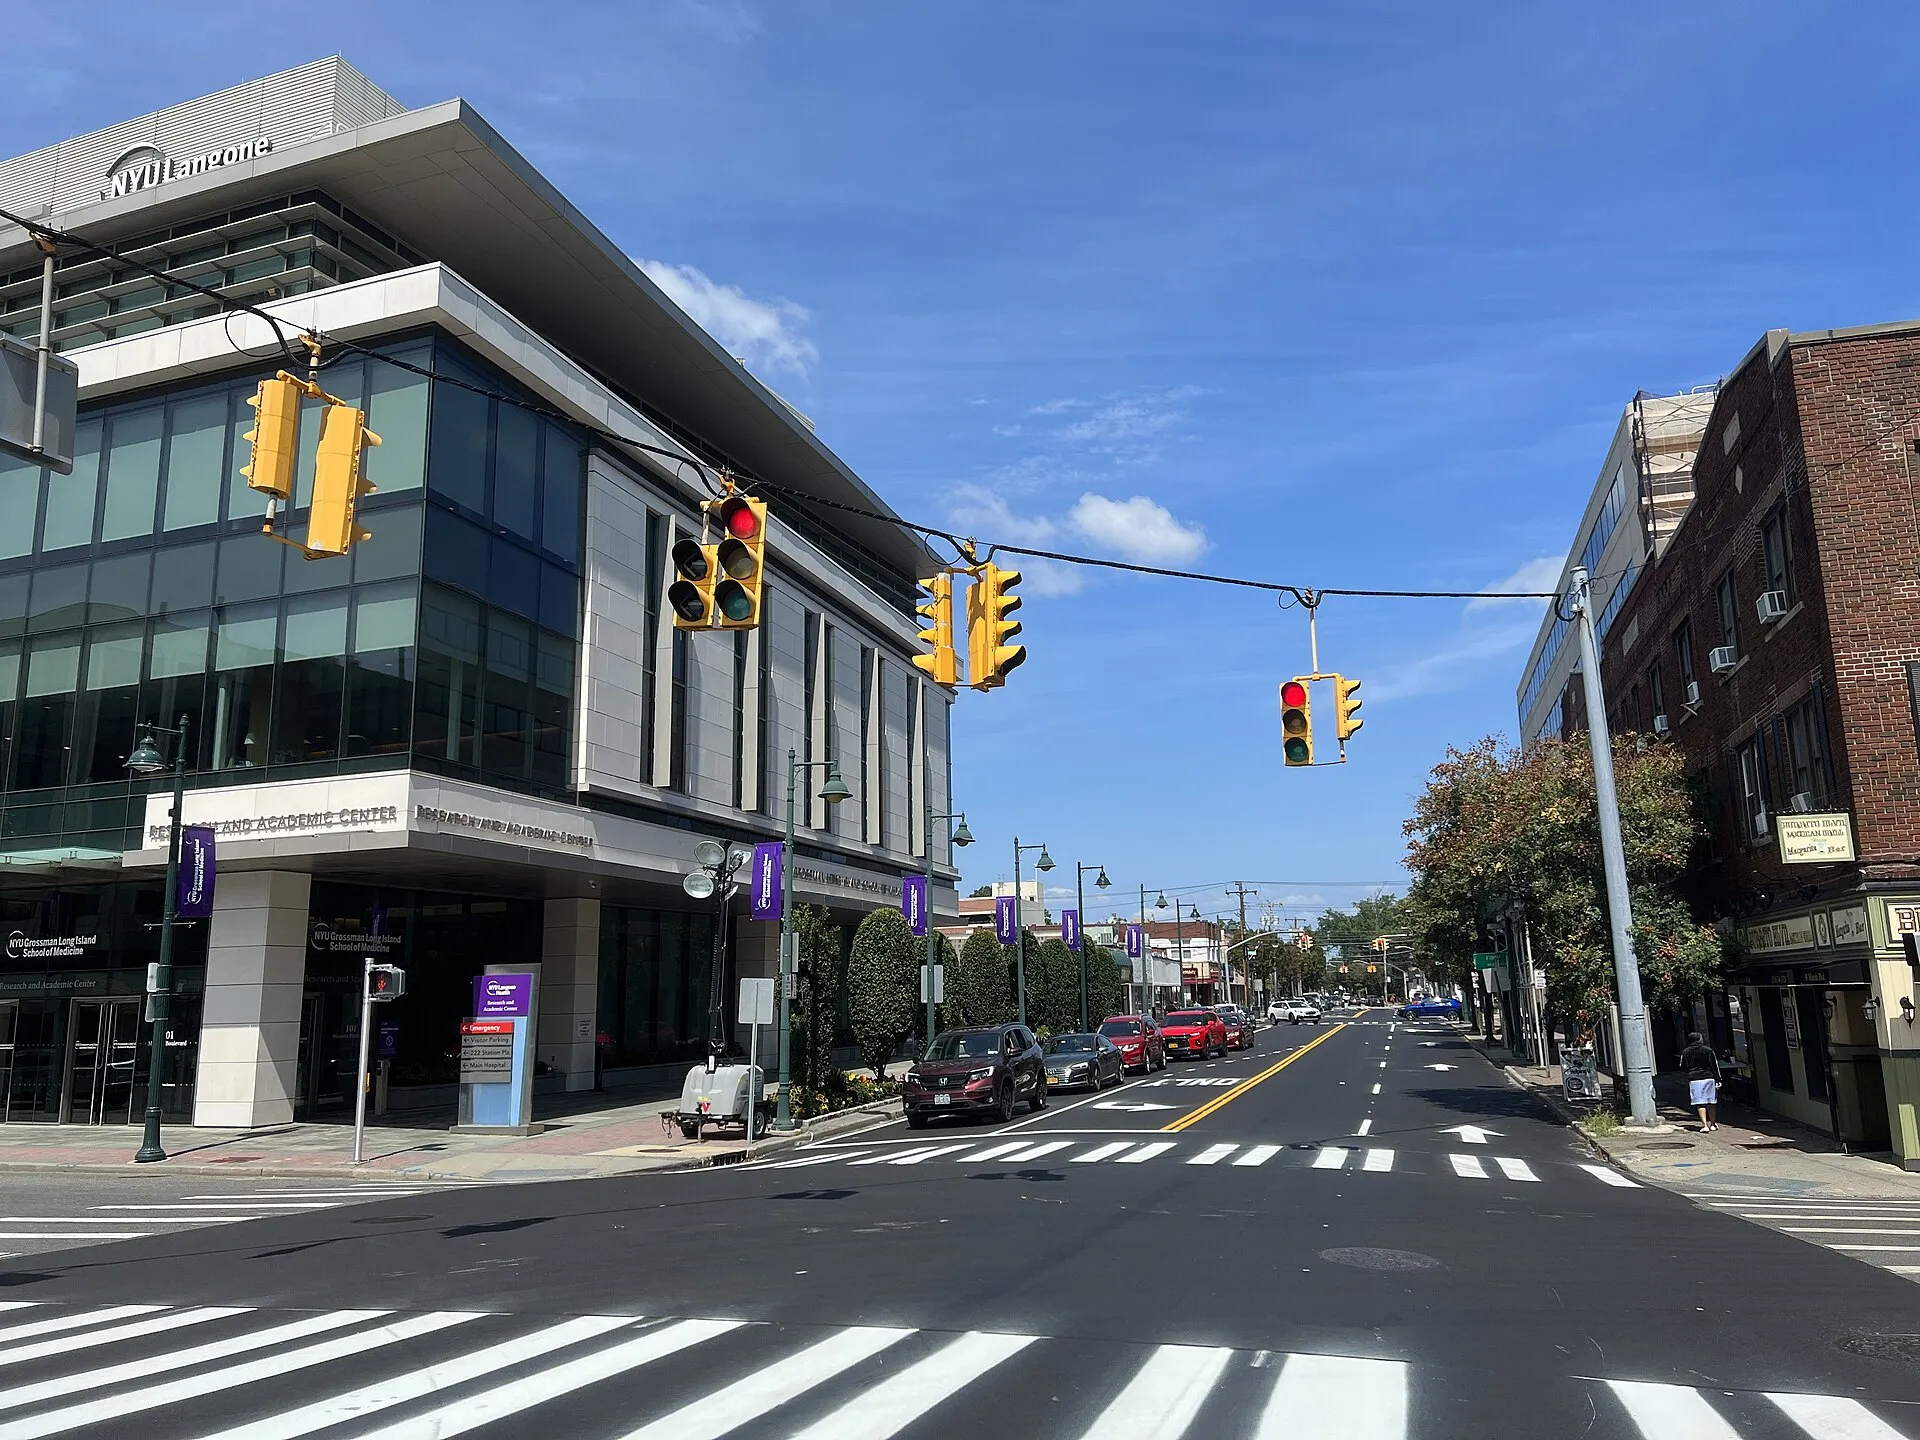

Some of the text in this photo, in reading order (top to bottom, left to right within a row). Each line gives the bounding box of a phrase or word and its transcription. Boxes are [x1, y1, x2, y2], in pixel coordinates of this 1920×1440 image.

[111, 136, 271, 198] NYU Langone
[223, 819, 251, 833] AND
[257, 811, 333, 830] ACADEMIC
[339, 806, 397, 824] CENTER
[1827, 845, 1846, 854] Bar
[9, 935, 97, 948] NYU Grossman Long Island
[314, 931, 401, 944] NYU Grossman Long Island
[23, 946, 84, 958] School of Medicine
[329, 941, 390, 952] School of Medicine
[0, 979, 96, 990] Research and Academic Center
[469, 1024, 500, 1033] Emergency
[1141, 1077, 1243, 1088] ONLY
